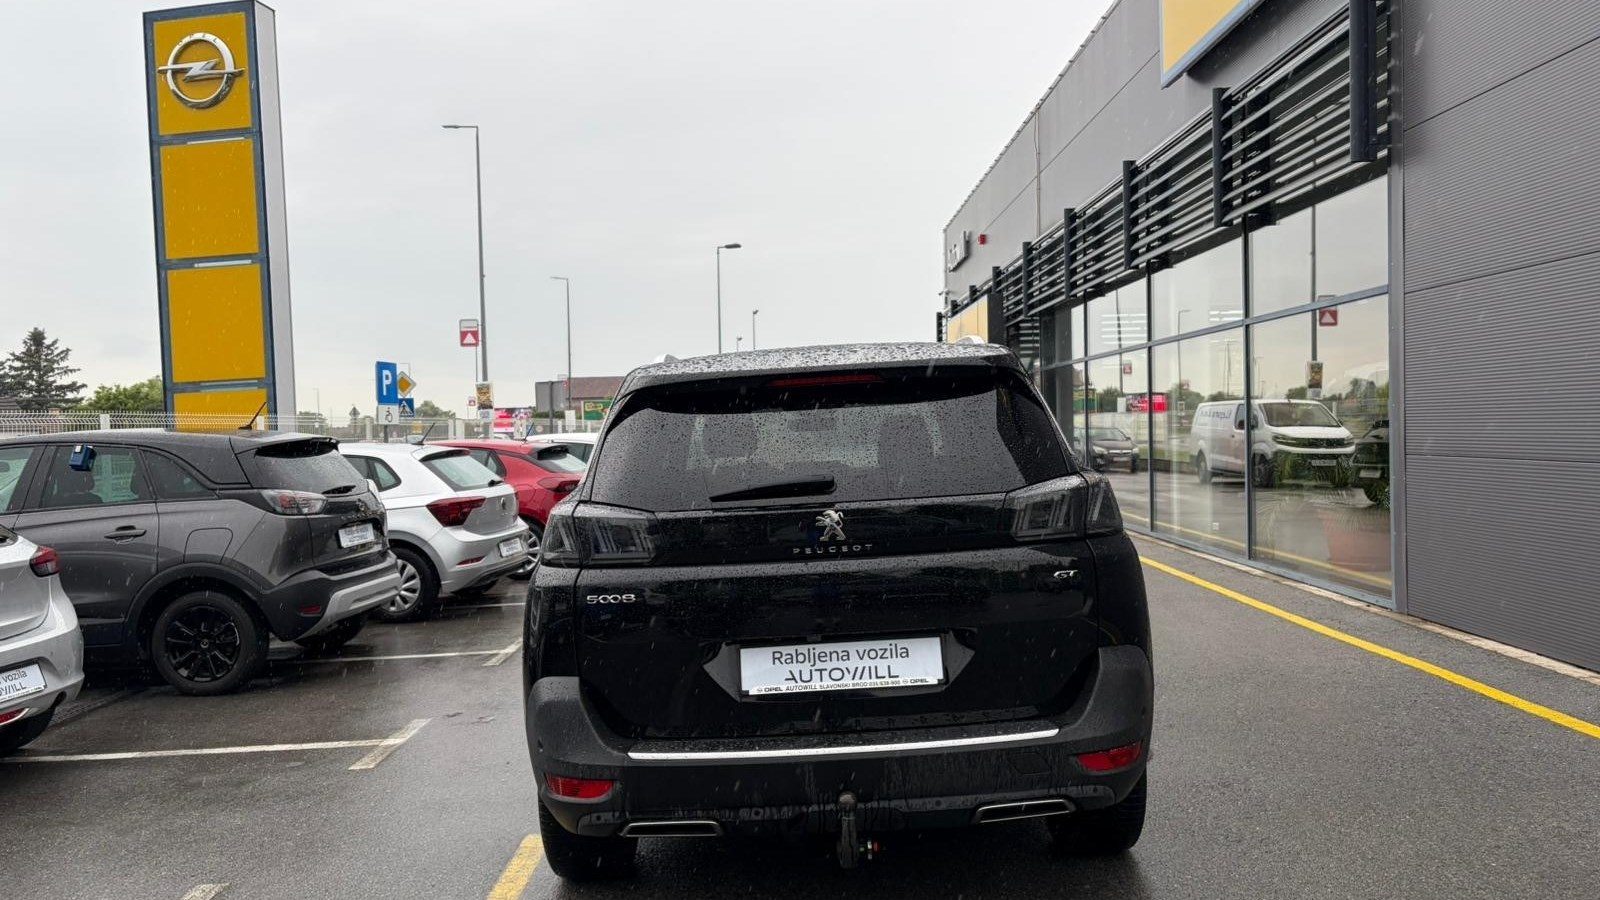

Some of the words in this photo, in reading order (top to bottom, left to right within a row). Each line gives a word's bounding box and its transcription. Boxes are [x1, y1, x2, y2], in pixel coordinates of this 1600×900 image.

[382, 370, 392, 396] P
[793, 544, 873, 554] PEUGEOT
[1054, 570, 1078, 579] GT
[586, 594, 636, 604] 5008
[772, 647, 850, 667] Rabljena
[856, 643, 909, 661] vozila
[2, 670, 28, 682] vozila
[784, 665, 900, 684] AUTOWILL
[785, 683, 818, 692] AUTOWILL
